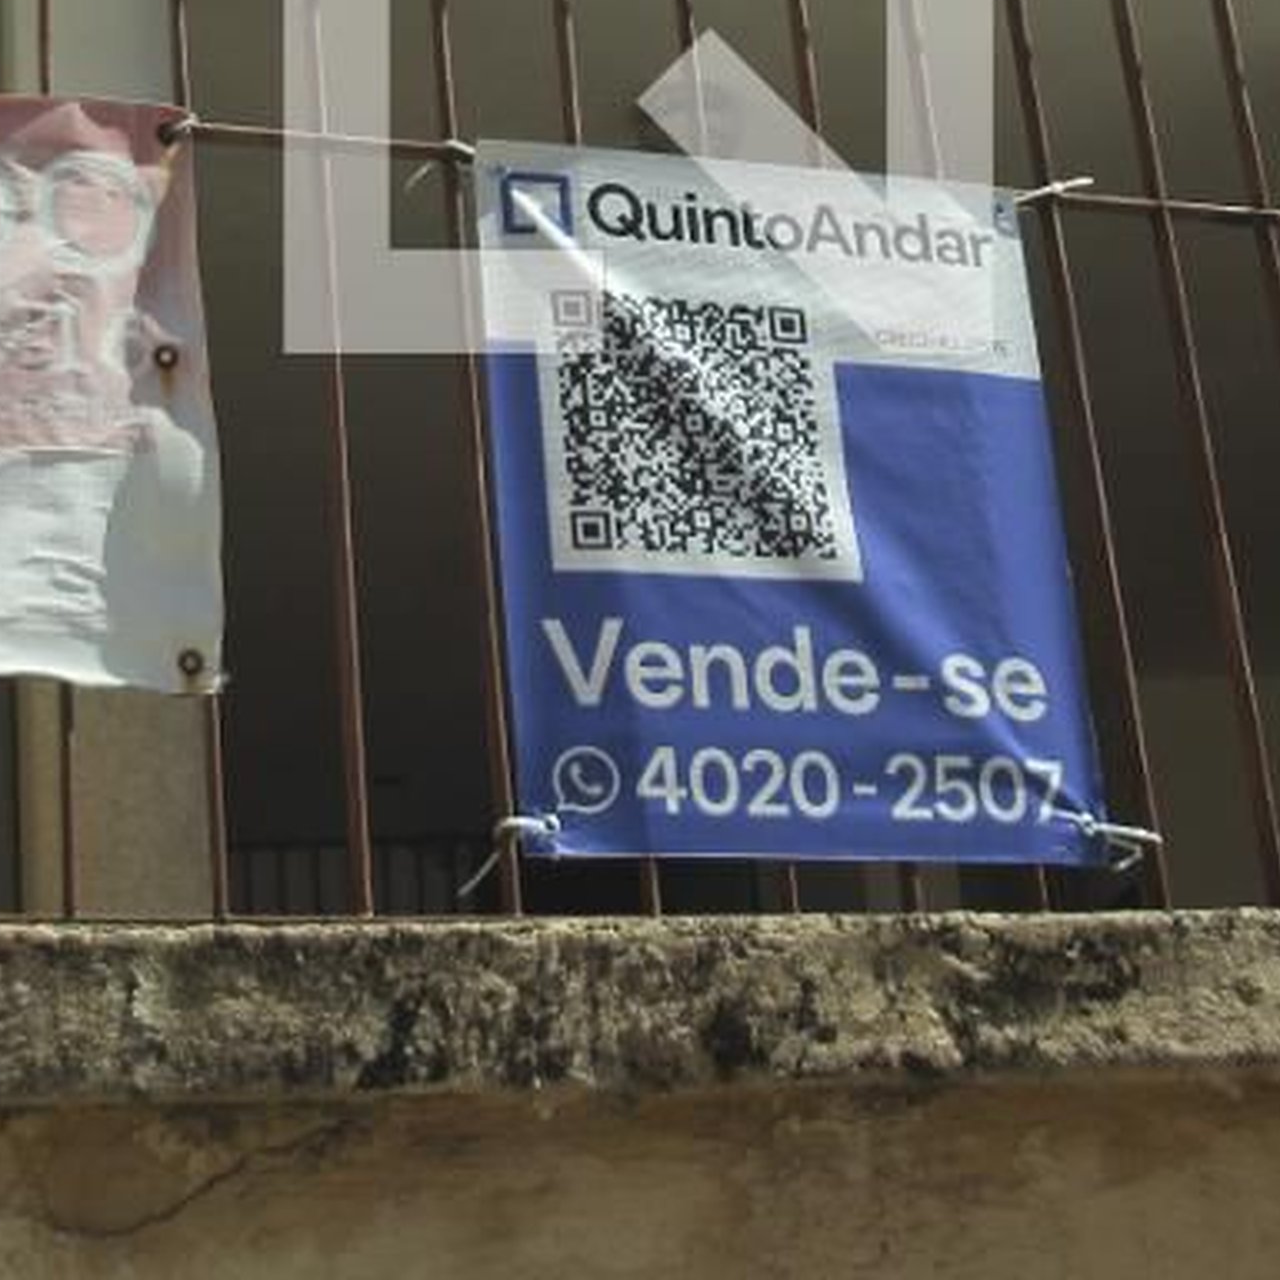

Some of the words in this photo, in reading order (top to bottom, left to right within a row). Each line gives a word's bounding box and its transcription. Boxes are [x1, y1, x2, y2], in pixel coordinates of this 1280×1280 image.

[587, 182, 996, 269] QuintoAndar
[542, 617, 1050, 722] Vende-se
[634, 745, 1066, 826] 4020-2507
